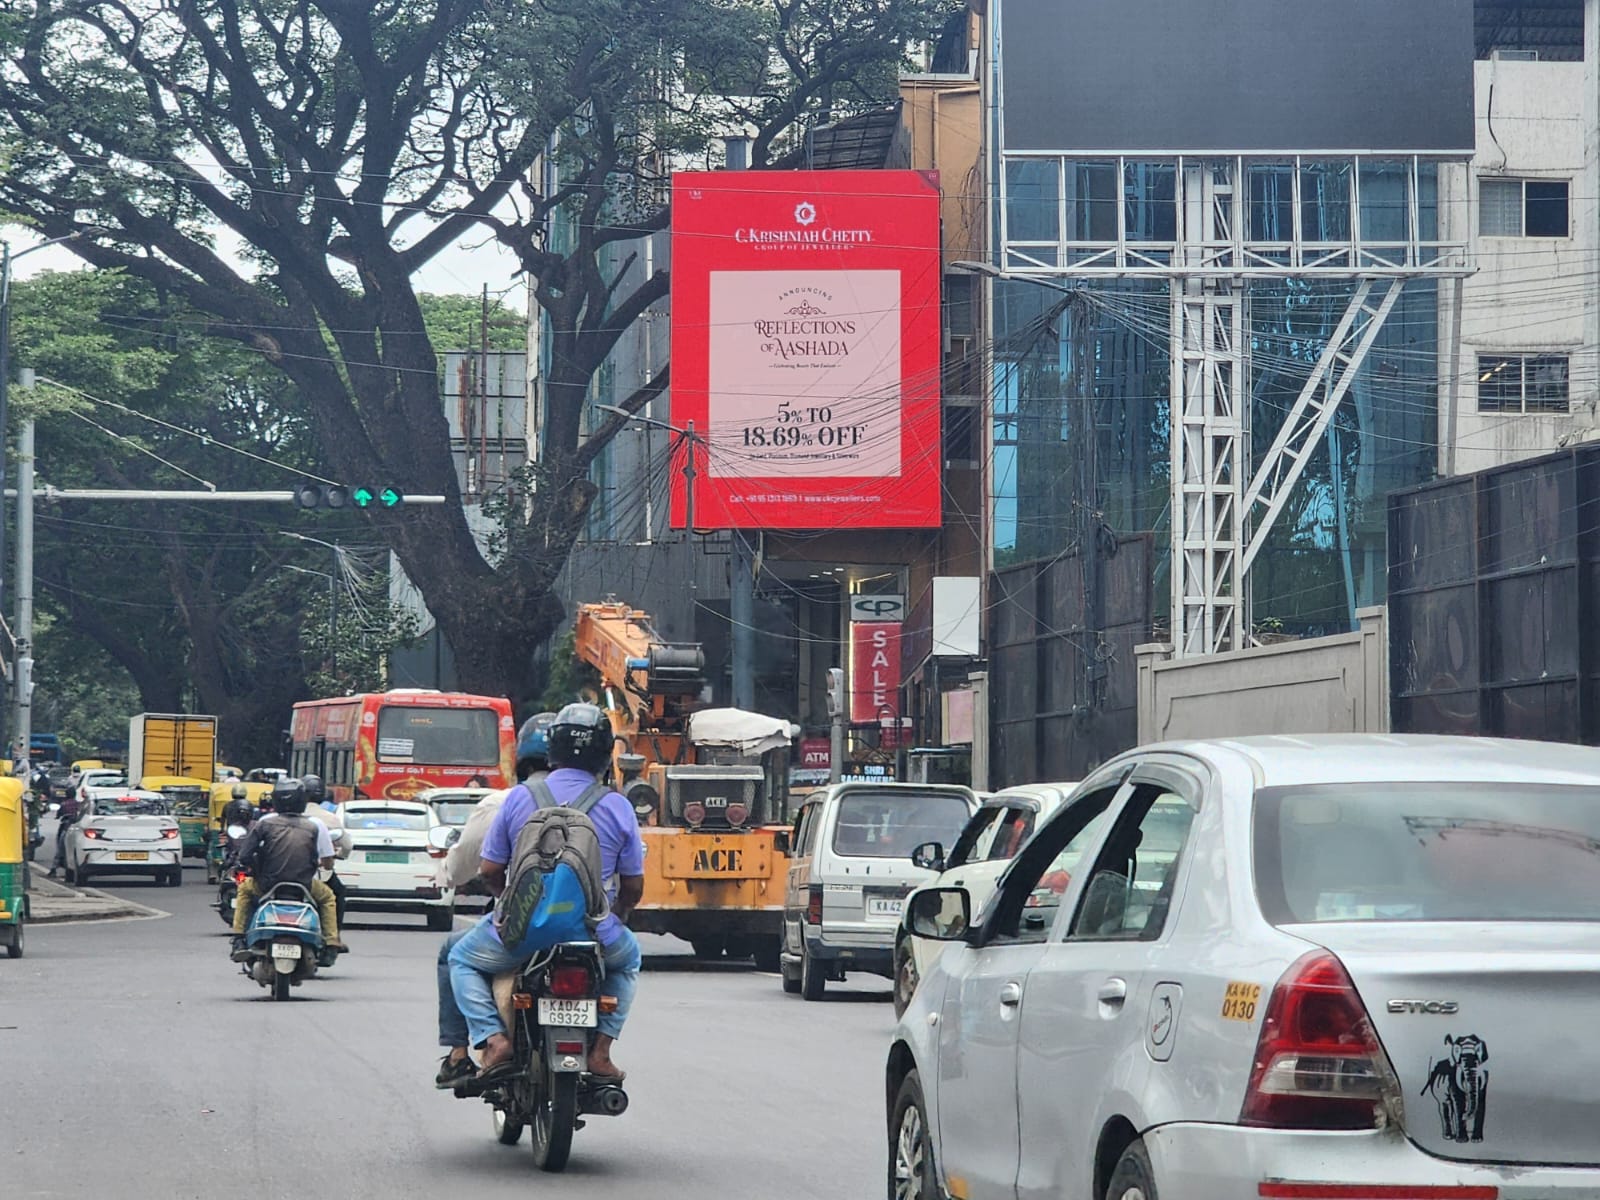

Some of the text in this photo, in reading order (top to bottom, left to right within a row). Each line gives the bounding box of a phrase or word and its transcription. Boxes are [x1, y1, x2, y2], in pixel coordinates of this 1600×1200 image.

[821, 227, 872, 242] CHETTY
[778, 287, 833, 301] ANNOUNCING
[754, 319, 856, 338] REFLECTIONS
[760, 337, 849, 360] OF AASHADA
[777, 401, 832, 423] 5% TO
[742, 426, 813, 447] 18.69%
[872, 630, 889, 706] SALE
[804, 752, 829, 762] ATM
[707, 798, 723, 806] ACE
[694, 849, 742, 872] ACE
[1225, 983, 1239, 997] KA
[1253, 985, 1261, 998] C
[550, 1000, 589, 1013] KA04J
[1222, 998, 1255, 1020] 0130
[1387, 999, 1459, 1014] ETIOS
[549, 1012, 589, 1025] G9322
